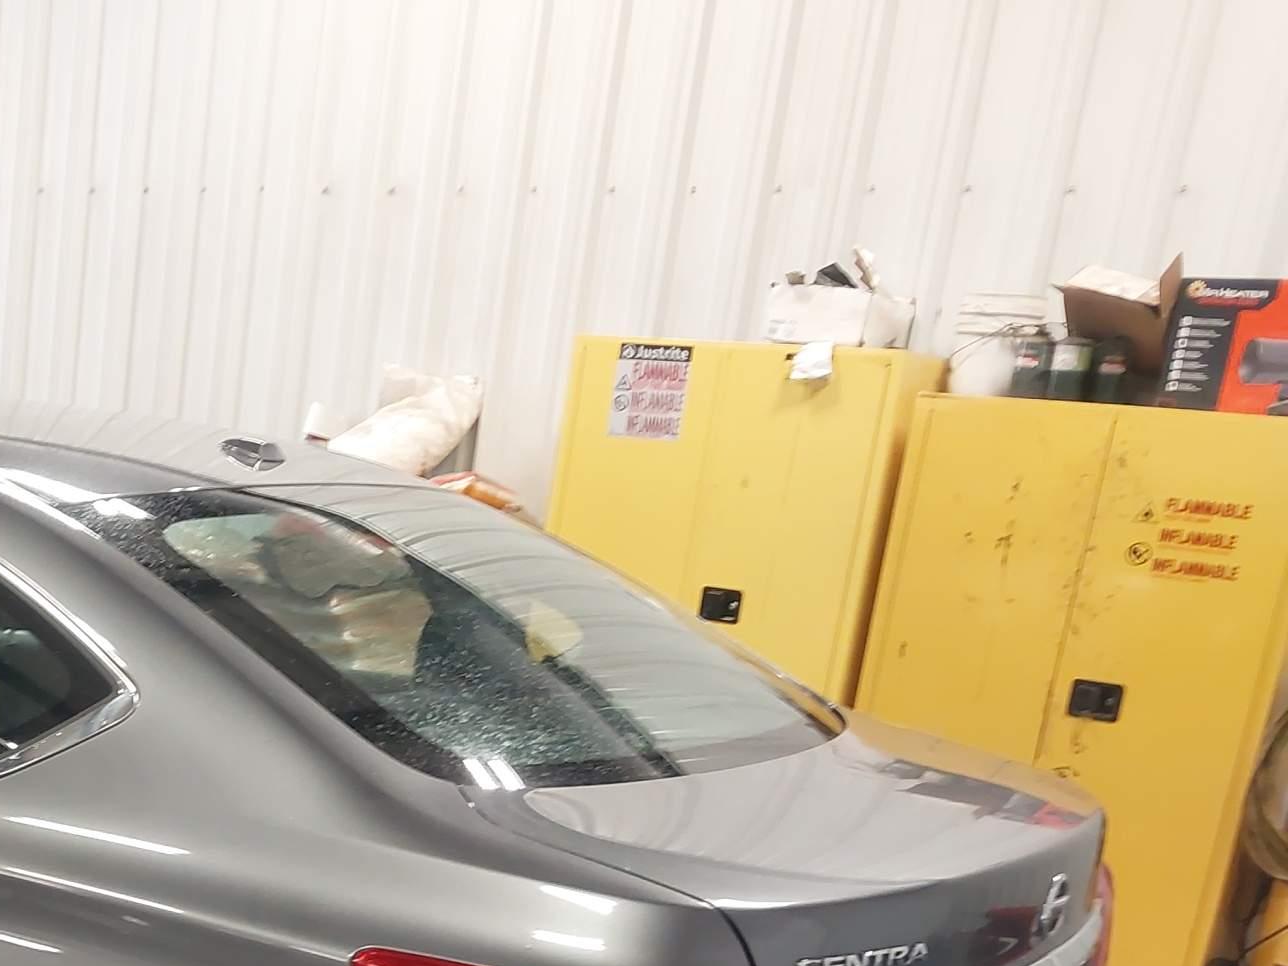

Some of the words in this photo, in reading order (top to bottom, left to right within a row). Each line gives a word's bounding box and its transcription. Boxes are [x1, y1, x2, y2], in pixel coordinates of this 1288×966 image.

[635, 345, 690, 360] Justrite
[632, 361, 689, 382] FLAMMABLE
[1166, 497, 1253, 519] FLAMMABLE
